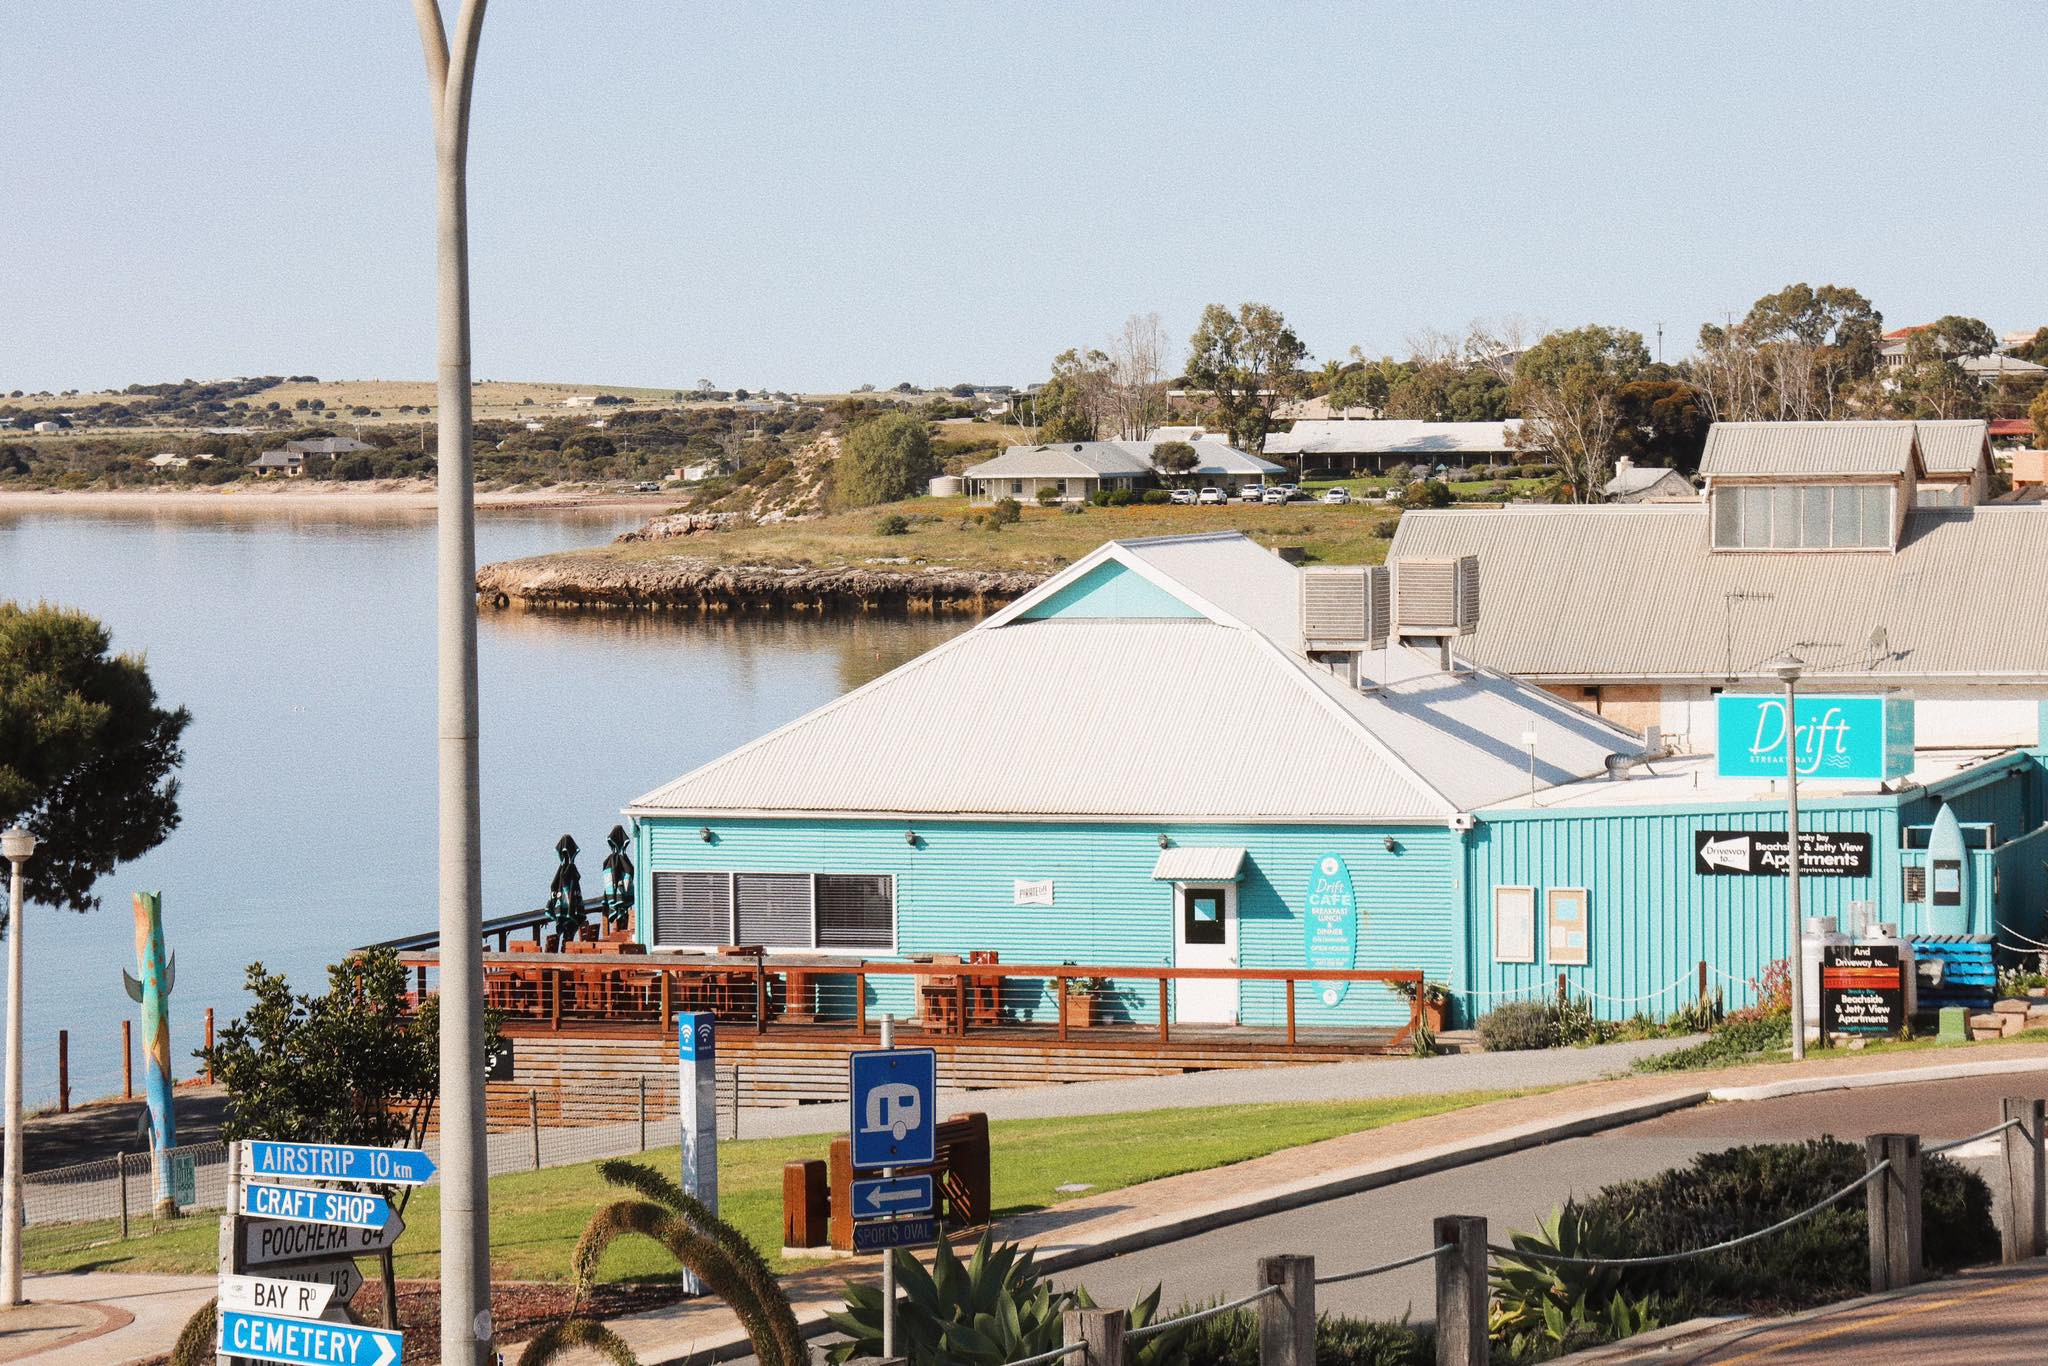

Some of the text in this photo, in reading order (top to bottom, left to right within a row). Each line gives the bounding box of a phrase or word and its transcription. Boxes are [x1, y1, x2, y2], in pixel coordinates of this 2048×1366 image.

[1748, 700, 1851, 774] Drift
[1706, 846, 1746, 856] Driveway
[1803, 842, 1812, 851] &
[1814, 843, 1837, 853] Jetty
[1840, 843, 1864, 852] View
[1854, 948, 1871, 956] And
[1835, 958, 1872, 968] Driveway
[1841, 994, 1883, 1004] Beachside
[1835, 1004, 1890, 1015] & Jetty View
[1838, 1014, 1888, 1025] Apartments
[262, 1146, 412, 1178] AIRSTRIP 10 km
[256, 1187, 375, 1223] CRAFT SHOP
[262, 1224, 348, 1256] POOCHERA
[858, 1223, 930, 1244] SPORTS OVAL
[254, 1283, 288, 1308] BAY
[233, 1318, 363, 1363] CEMETERY
